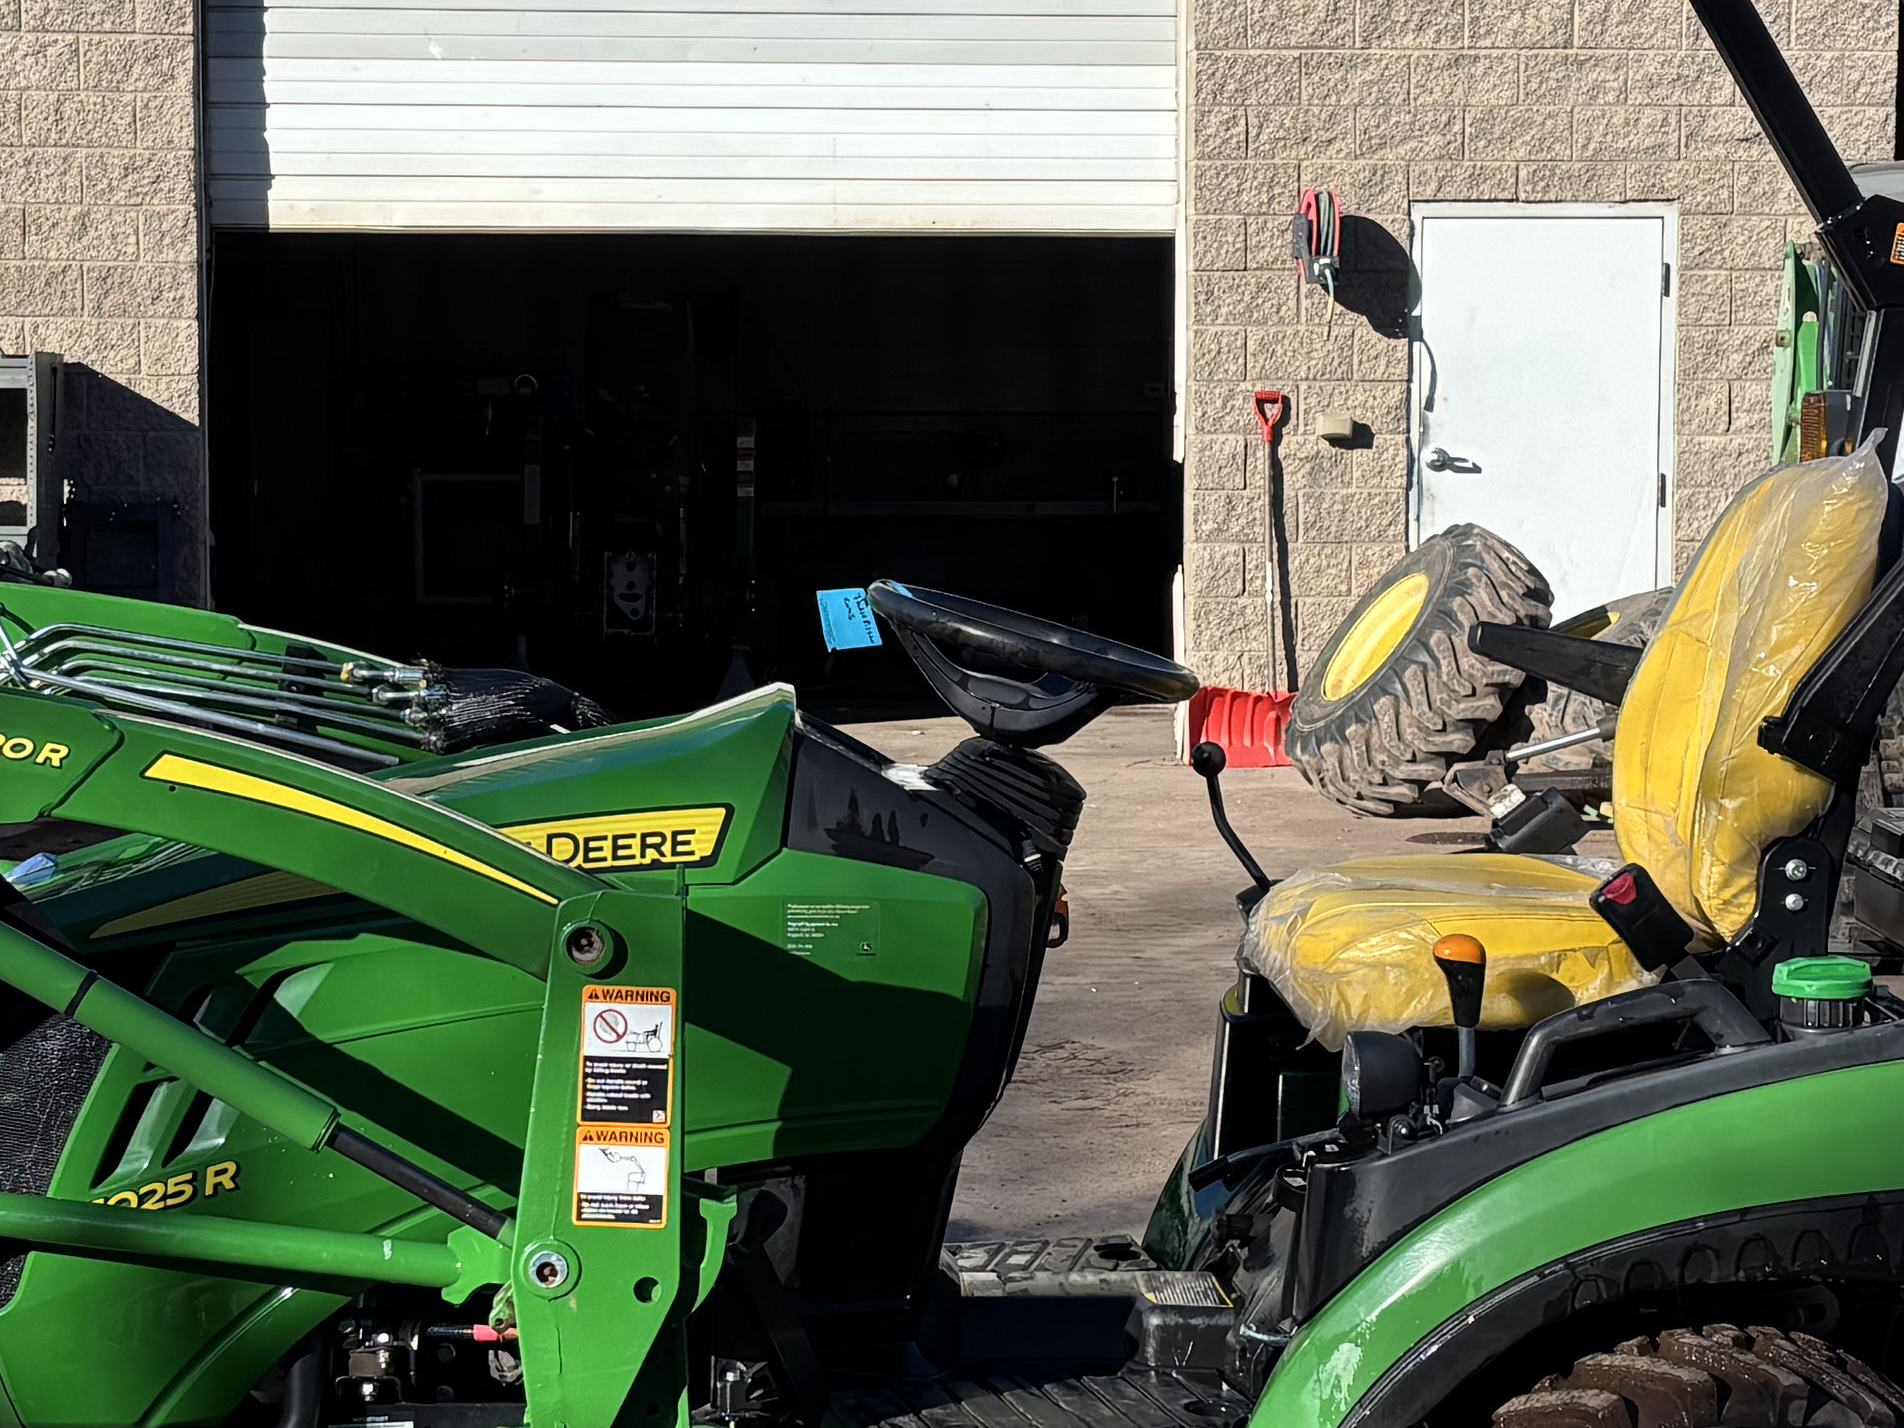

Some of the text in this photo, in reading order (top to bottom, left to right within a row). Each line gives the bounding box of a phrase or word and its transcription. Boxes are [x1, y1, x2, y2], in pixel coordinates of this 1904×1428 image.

[34, 742, 70, 768] R
[545, 828, 697, 865] DEERE
[601, 988, 671, 1003] WARNING
[595, 1130, 665, 1144] WARNING
[91, 1160, 238, 1211] 025 R
